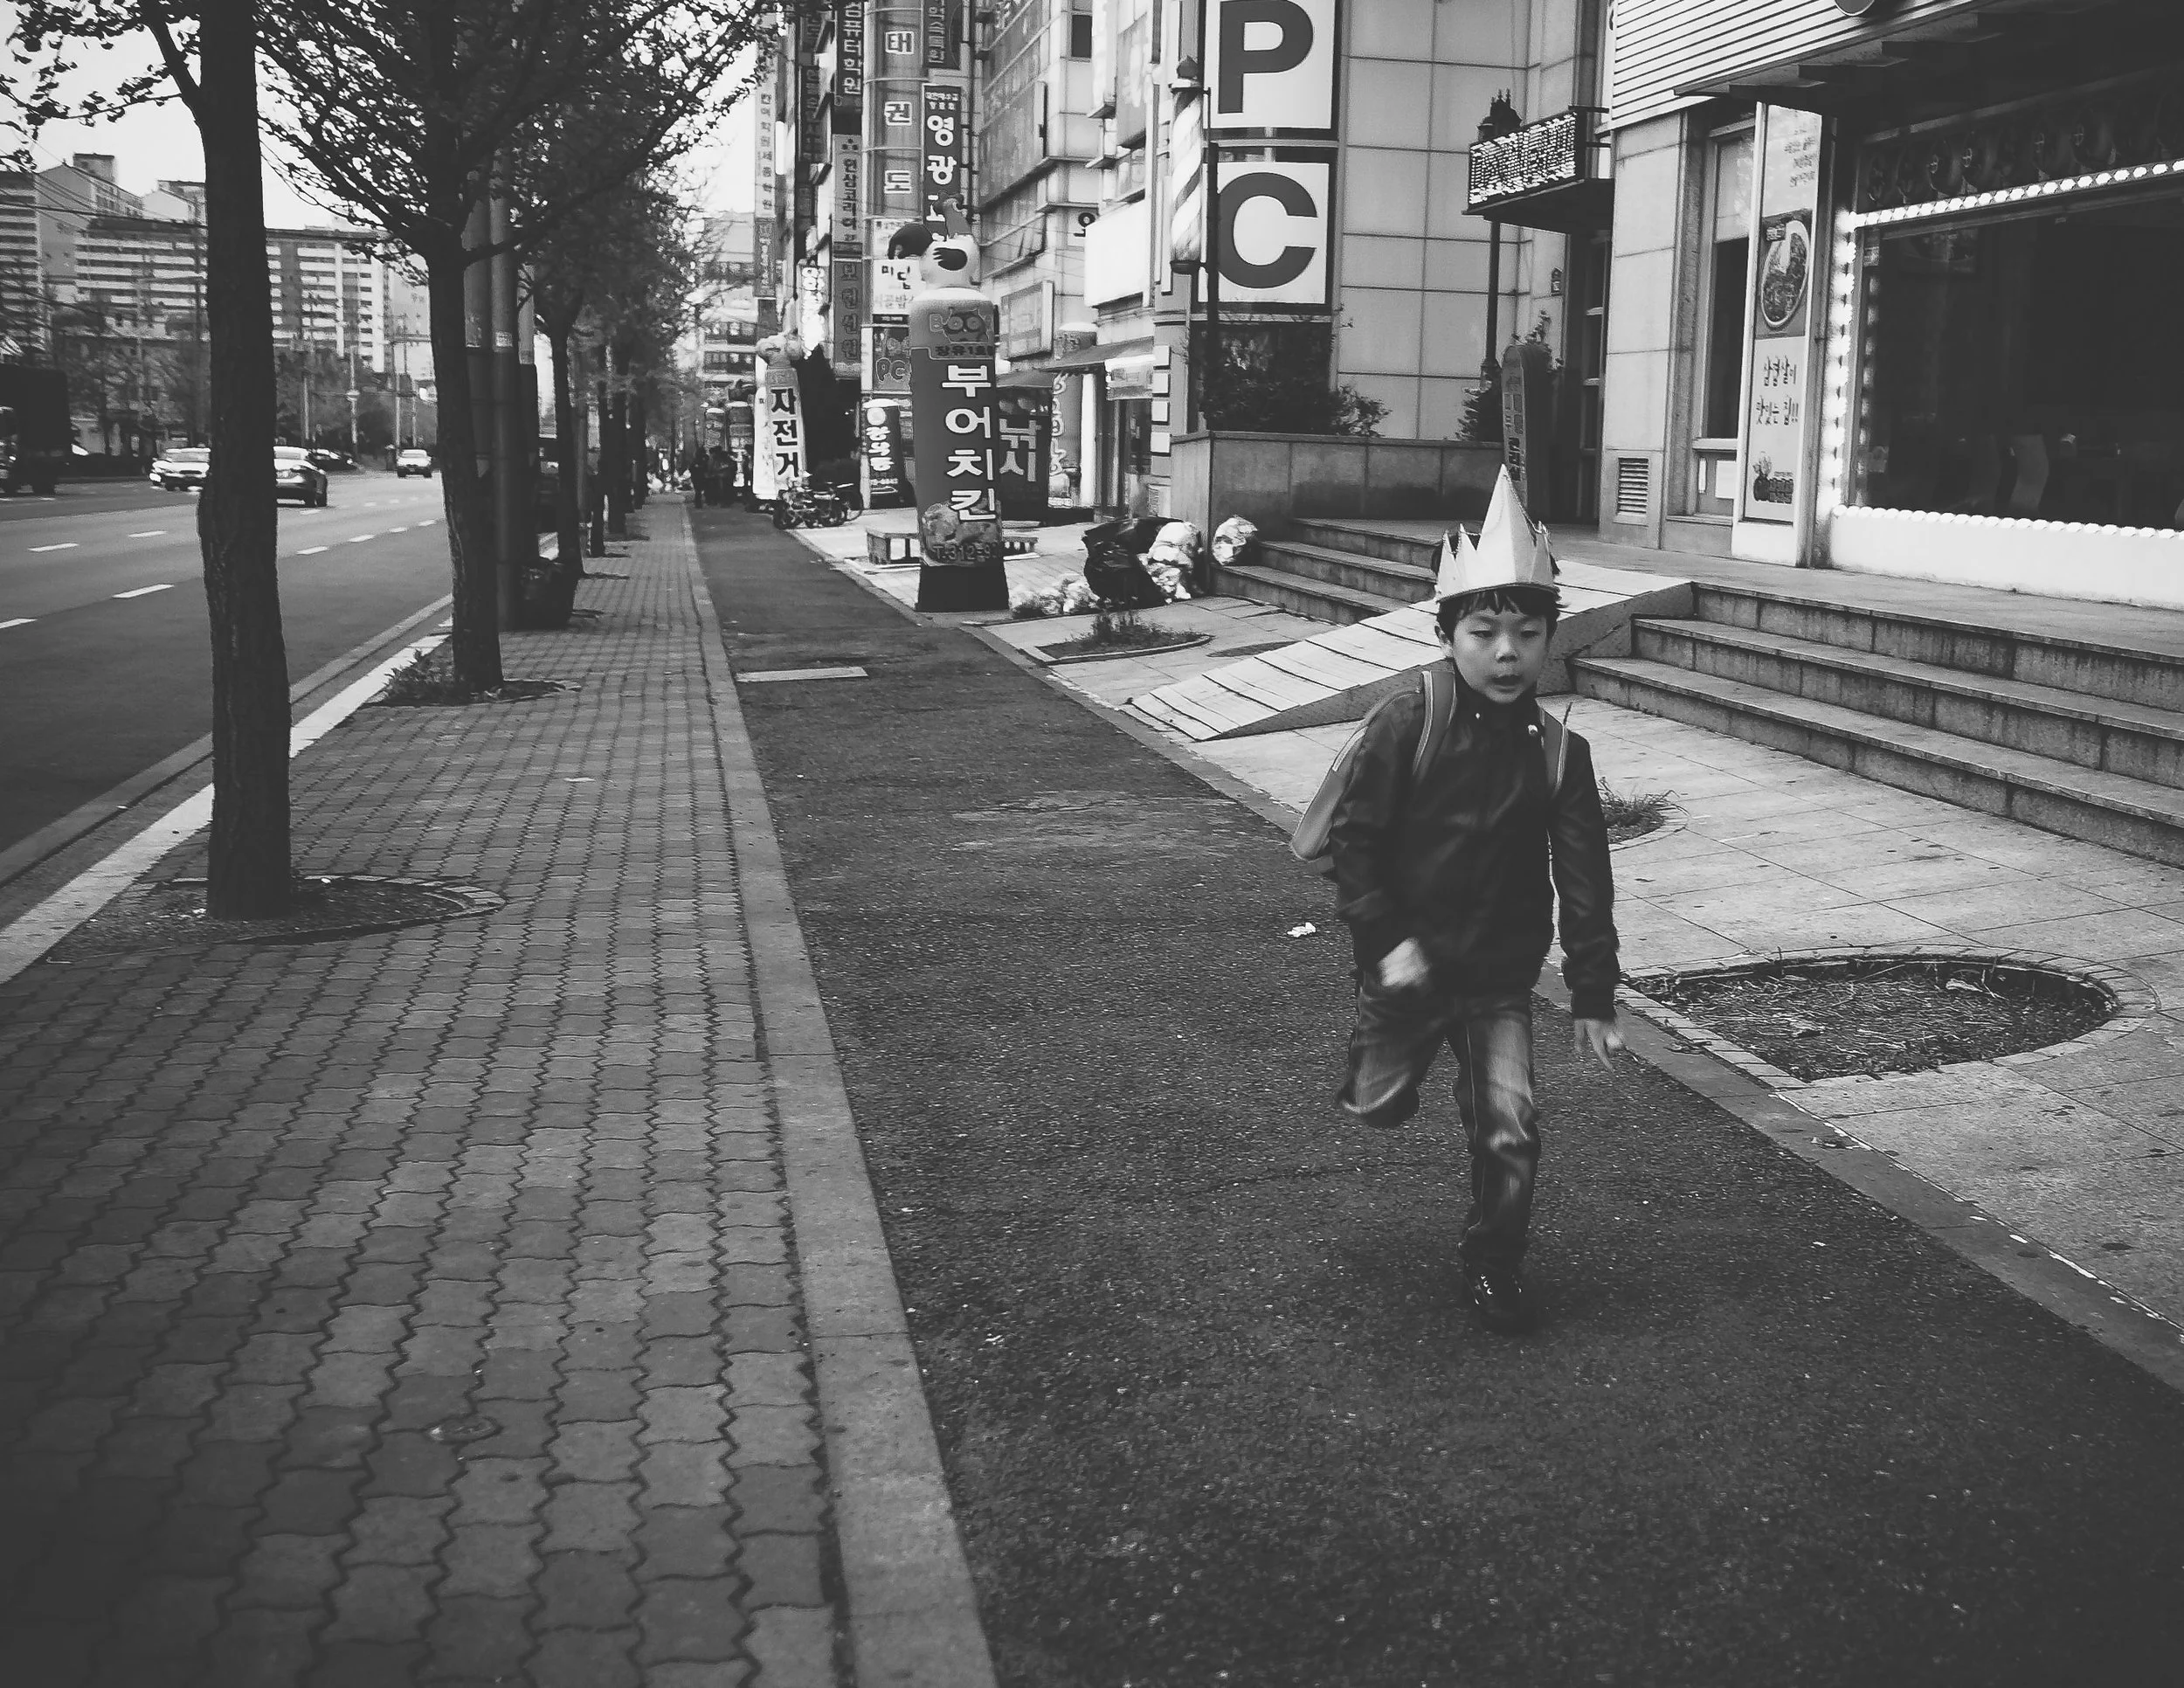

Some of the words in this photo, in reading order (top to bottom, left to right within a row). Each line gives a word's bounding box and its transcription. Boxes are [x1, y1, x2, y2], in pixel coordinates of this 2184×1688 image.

[884, 31, 915, 195] 태권도
[771, 387, 800, 478] 자전거
[941, 363, 997, 522] 부어치킨
